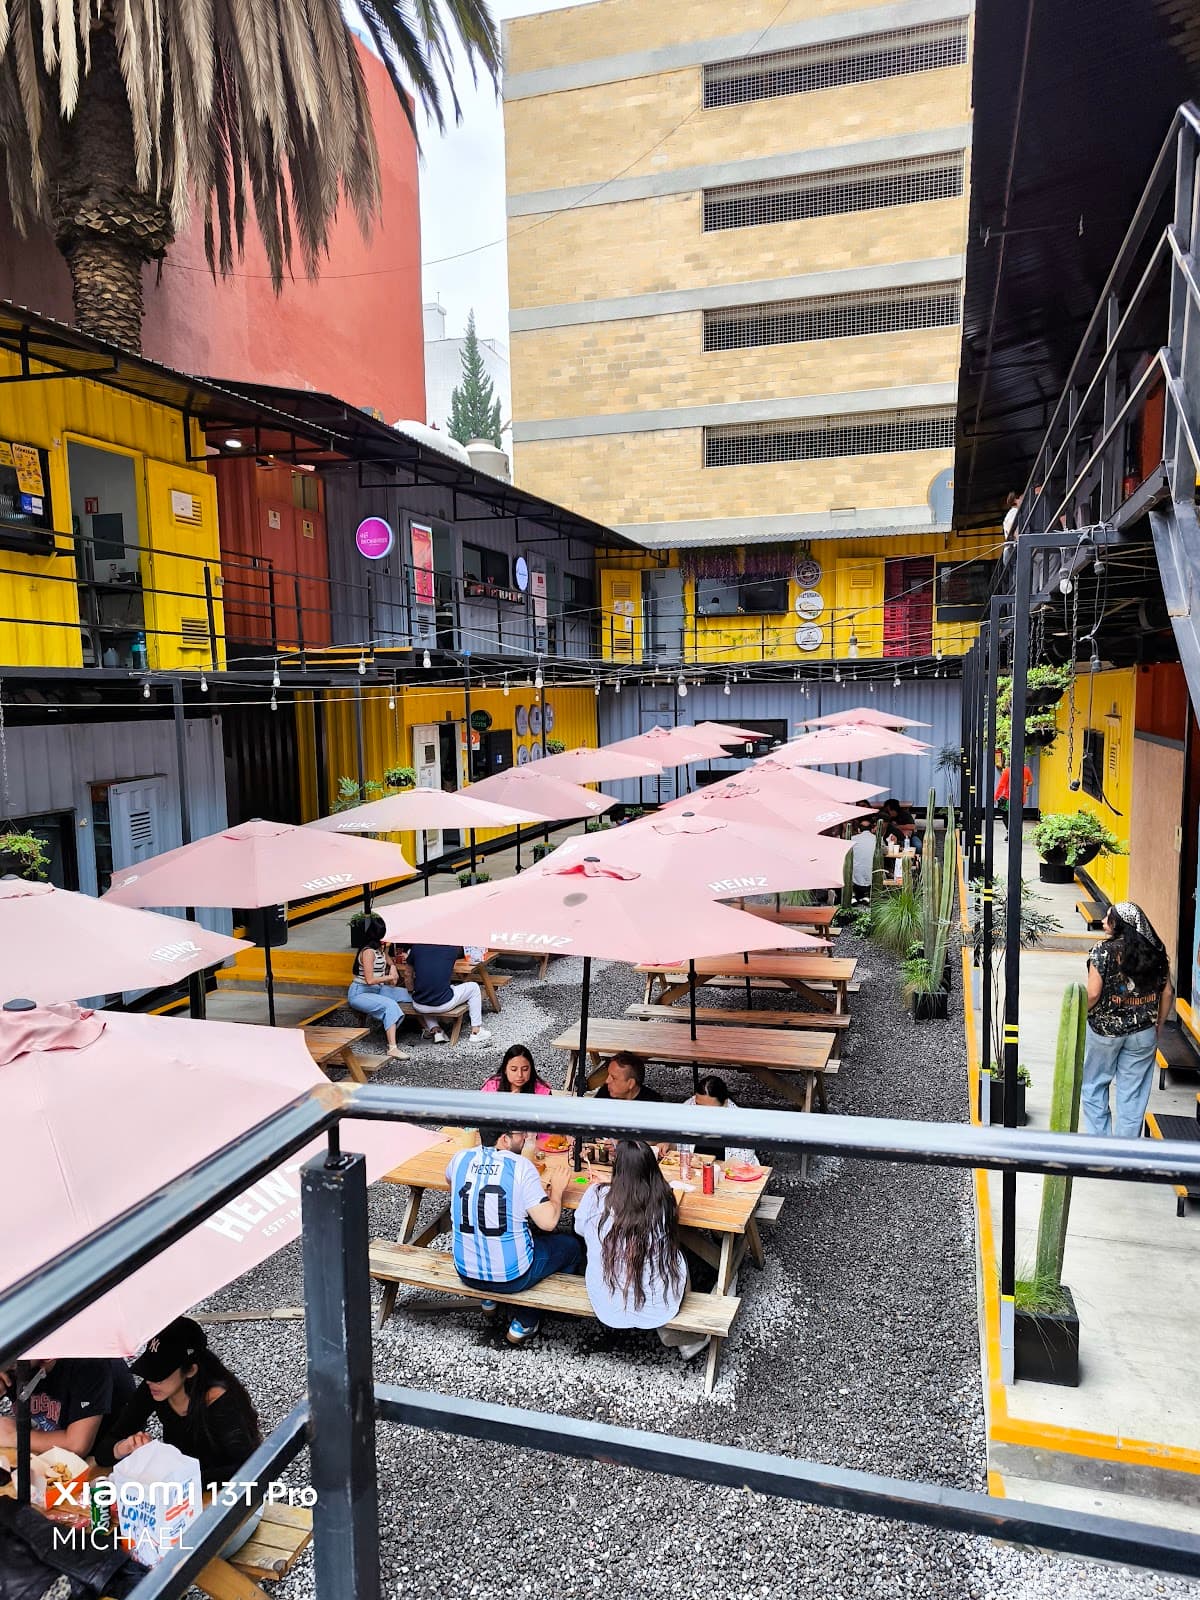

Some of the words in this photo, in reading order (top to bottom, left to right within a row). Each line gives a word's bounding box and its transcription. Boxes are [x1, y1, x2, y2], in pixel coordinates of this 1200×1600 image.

[302, 872, 353, 891] HEINZ
[708, 876, 769, 892] HEINZ
[490, 931, 575, 948] HEINZ
[470, 1163, 501, 1176] MESSI
[203, 1162, 302, 1243] HEIN
[459, 1181, 508, 1237] 10
